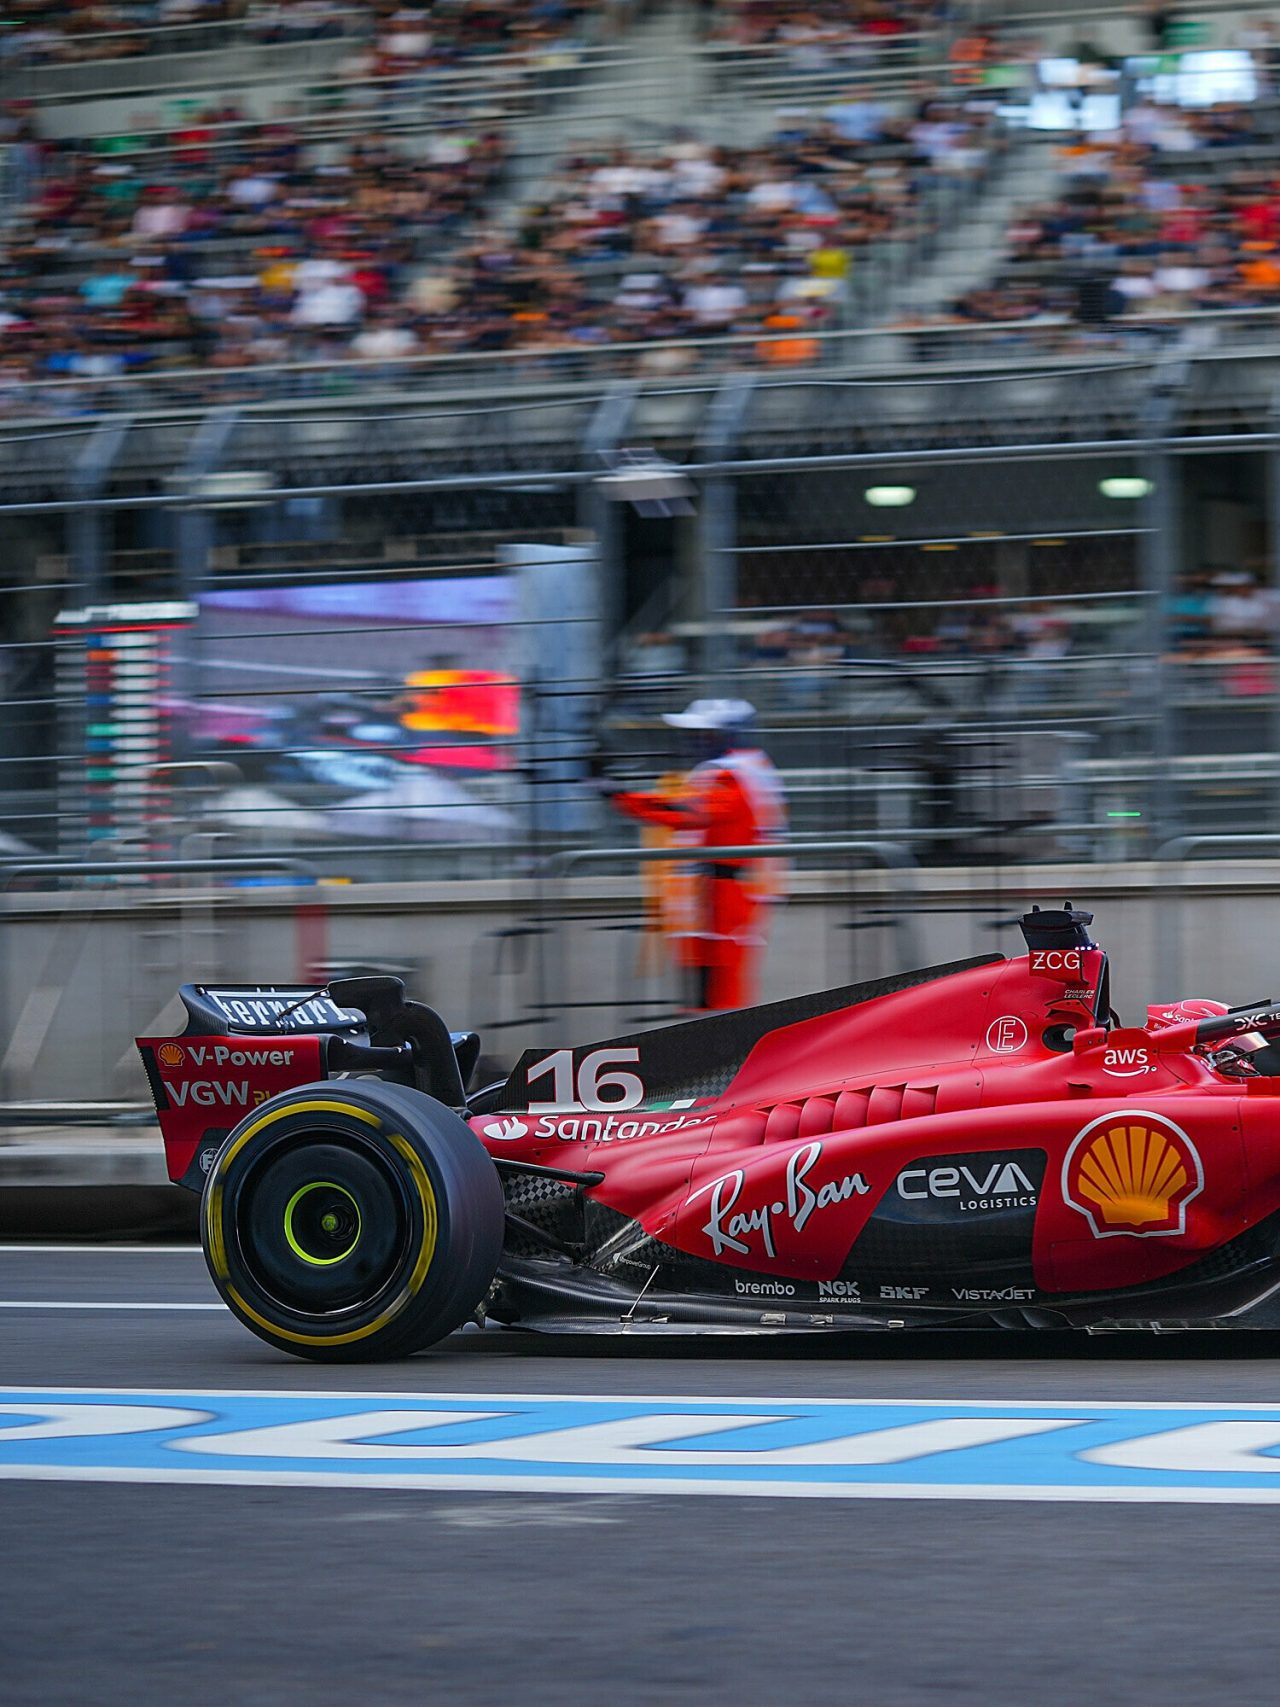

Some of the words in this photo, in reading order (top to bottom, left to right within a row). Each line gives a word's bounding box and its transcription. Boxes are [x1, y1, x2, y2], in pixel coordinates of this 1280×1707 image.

[1032, 951, 1081, 970] ZCG
[187, 1046, 294, 1066] V-Power
[1103, 1048, 1148, 1065] aws
[527, 1047, 644, 1114] 16
[164, 1081, 249, 1106] VGW
[534, 1115, 718, 1142] Santander
[959, 1196, 1037, 1211] LOGISTICS
[735, 1279, 796, 1296] brembo
[817, 1280, 861, 1296] NGK
[880, 1286, 930, 1300] SKF
